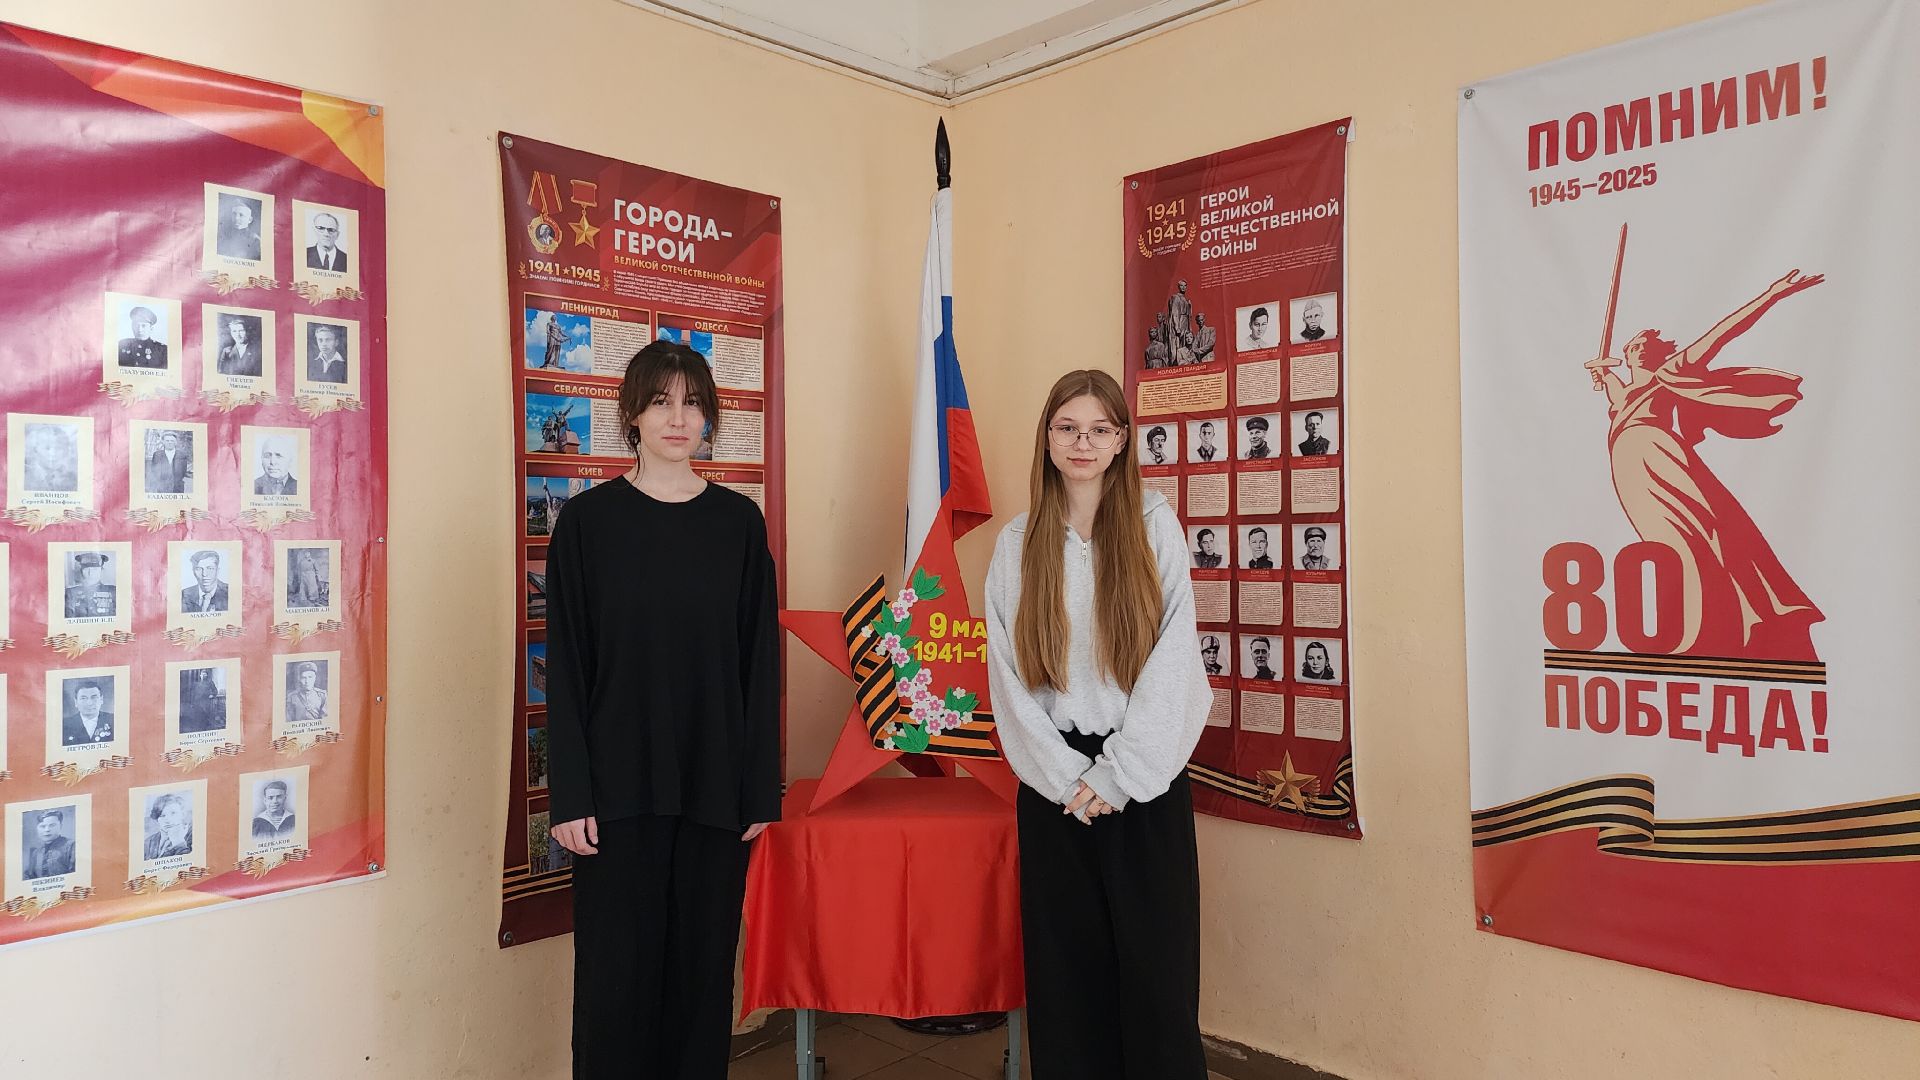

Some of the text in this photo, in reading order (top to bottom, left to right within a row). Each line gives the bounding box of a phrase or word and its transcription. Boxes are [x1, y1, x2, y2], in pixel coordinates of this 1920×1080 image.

[1528, 56, 1826, 171] ПОМНИМ!
[1201, 186, 1249, 209] ГЕРОИ
[1529, 163, 1657, 208] 1945–2025
[614, 199, 732, 241] ГОРОДА-
[1147, 198, 1185, 222] 1941
[1200, 198, 1339, 243] ОТЕЧЕСТВЕННОЙ
[1201, 194, 1274, 227] ВЕЛИКОЙ
[1147, 221, 1187, 245] 1945
[614, 229, 694, 264] ГЕРОИ
[1200, 238, 1257, 261] ВОЙНЫ
[528, 259, 601, 282] 1941 1945
[614, 255, 765, 288] ВЕЛИКОЙ ОТЕЧЕСТВЕННОЙ ВОЙНЫ
[560, 302, 620, 319] ЛЕНИНГРАД
[695, 321, 729, 333] ОДЕССА
[553, 384, 620, 398] СЕВАСТОПОЛ
[577, 466, 604, 476] КИЕВ
[701, 472, 726, 481] БРЕСТ
[1542, 541, 1685, 655] 80
[929, 612, 988, 639] 9 МА
[913, 640, 988, 664] 1941-1
[1544, 674, 1829, 757] ПОБЕДА!
